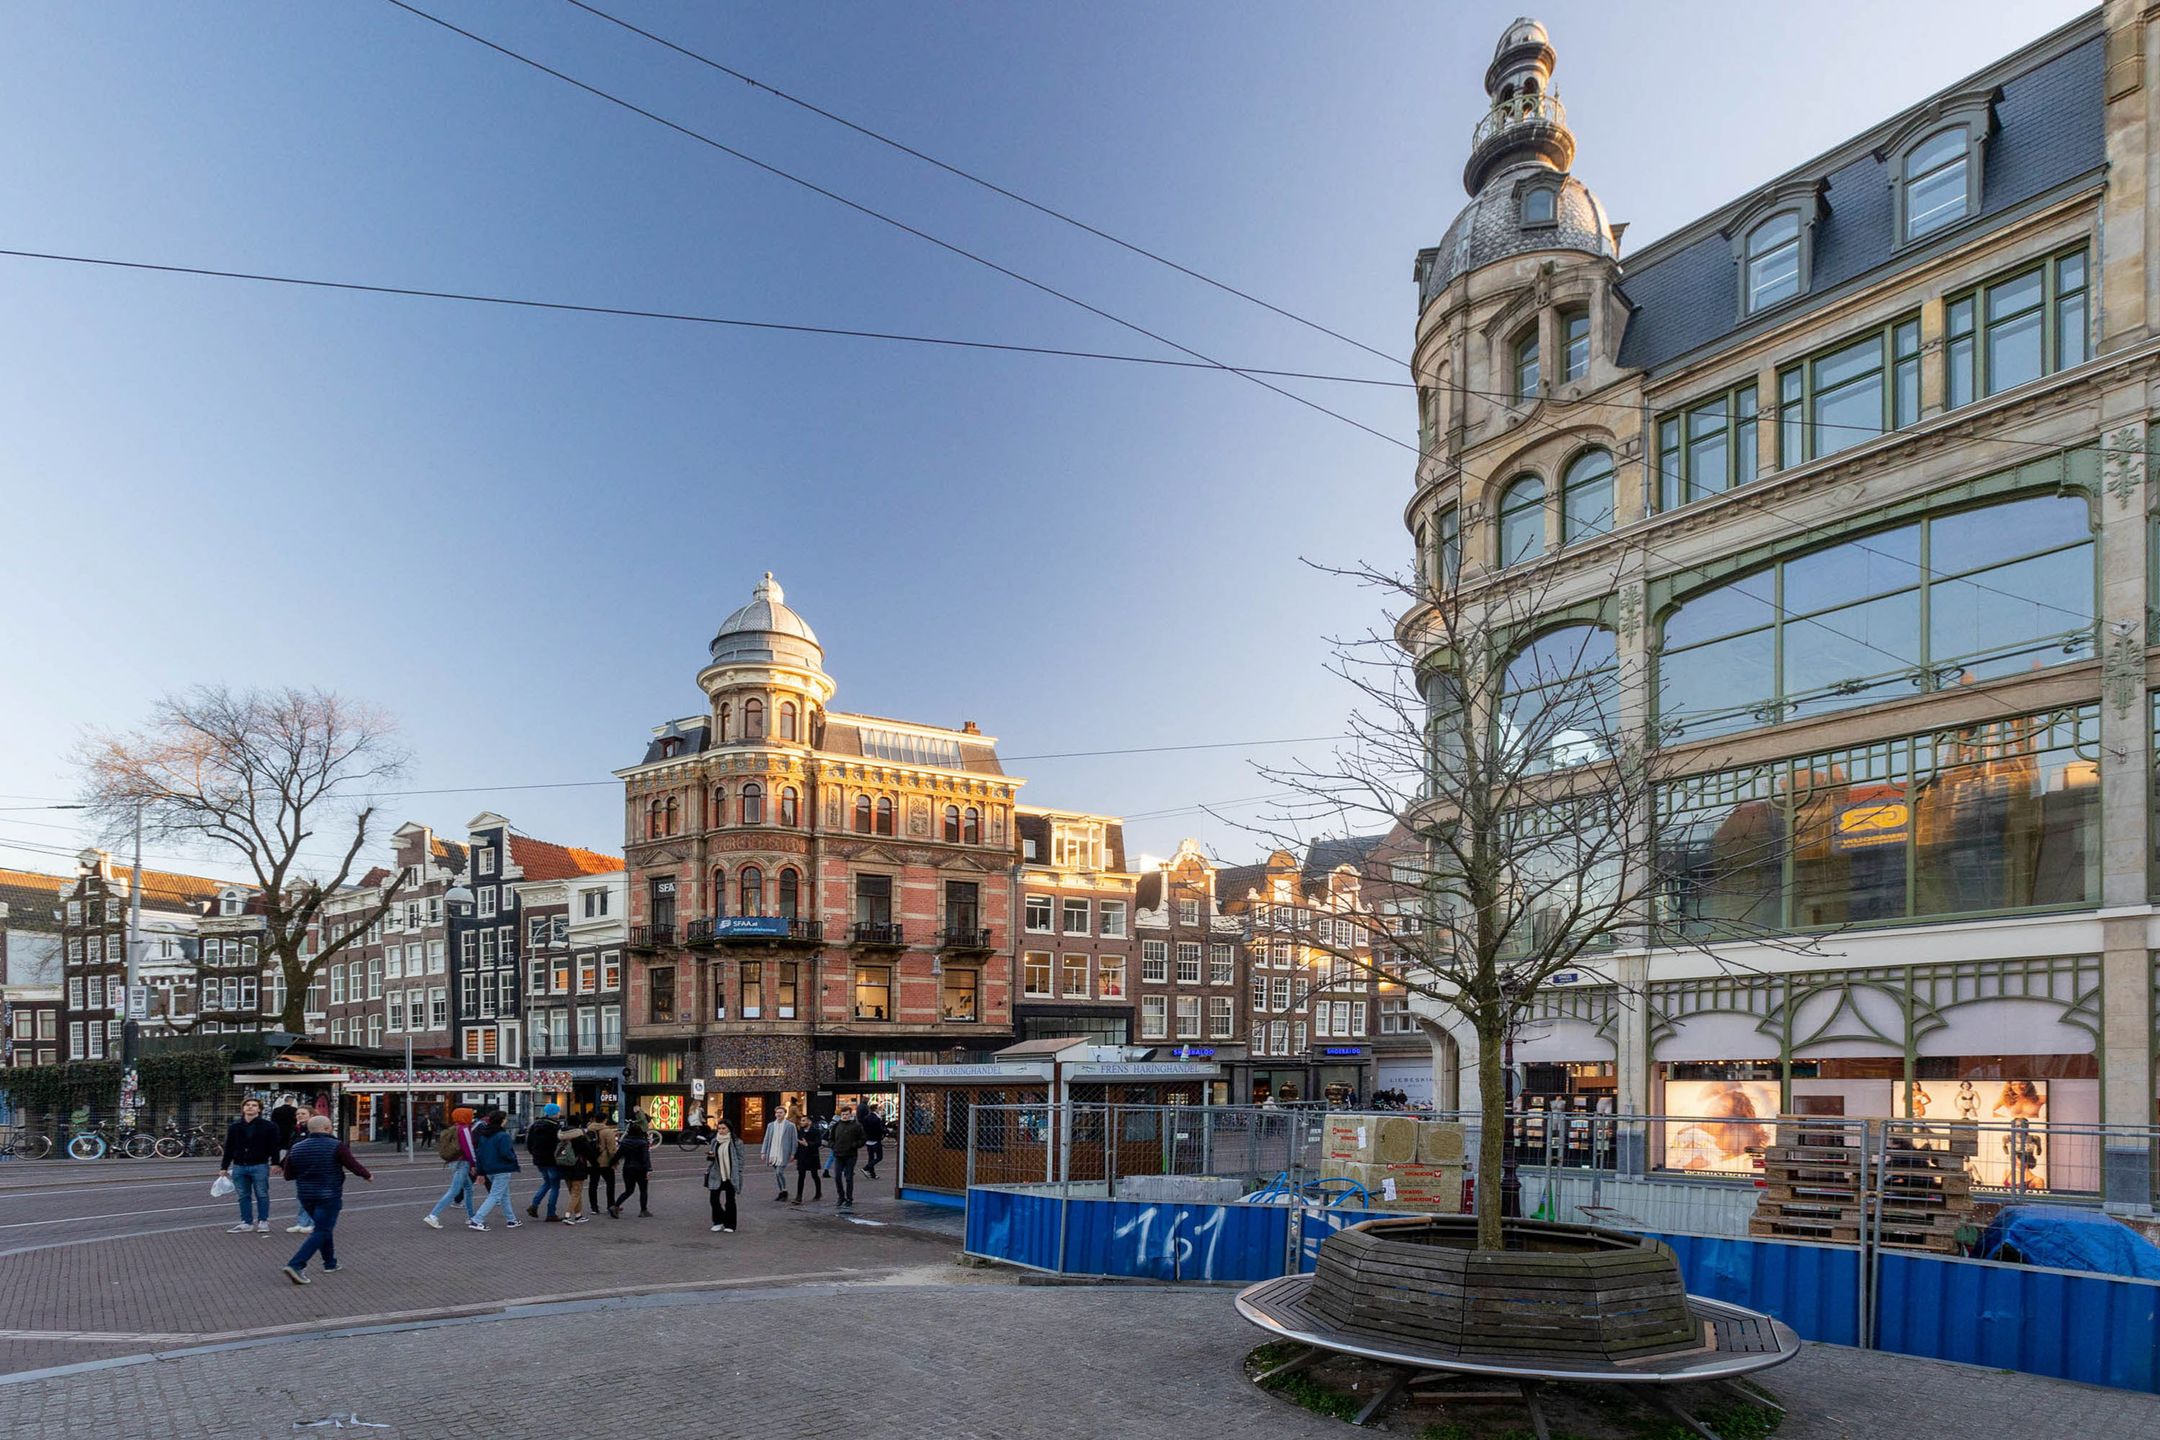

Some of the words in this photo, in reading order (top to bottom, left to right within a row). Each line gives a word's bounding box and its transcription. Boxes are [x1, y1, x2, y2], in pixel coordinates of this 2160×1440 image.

[1173, 1048, 1216, 1056] SHEBALOO
[918, 1067, 941, 1076] FRENS
[943, 1066, 1002, 1076] HARINGHANDEL
[1101, 1064, 1129, 1074] FRENS
[1133, 1063, 1200, 1074] HARINGHANDEL
[600, 1094, 618, 1102] OPEN
[1968, 1186, 2012, 1194] CTORIA'S
